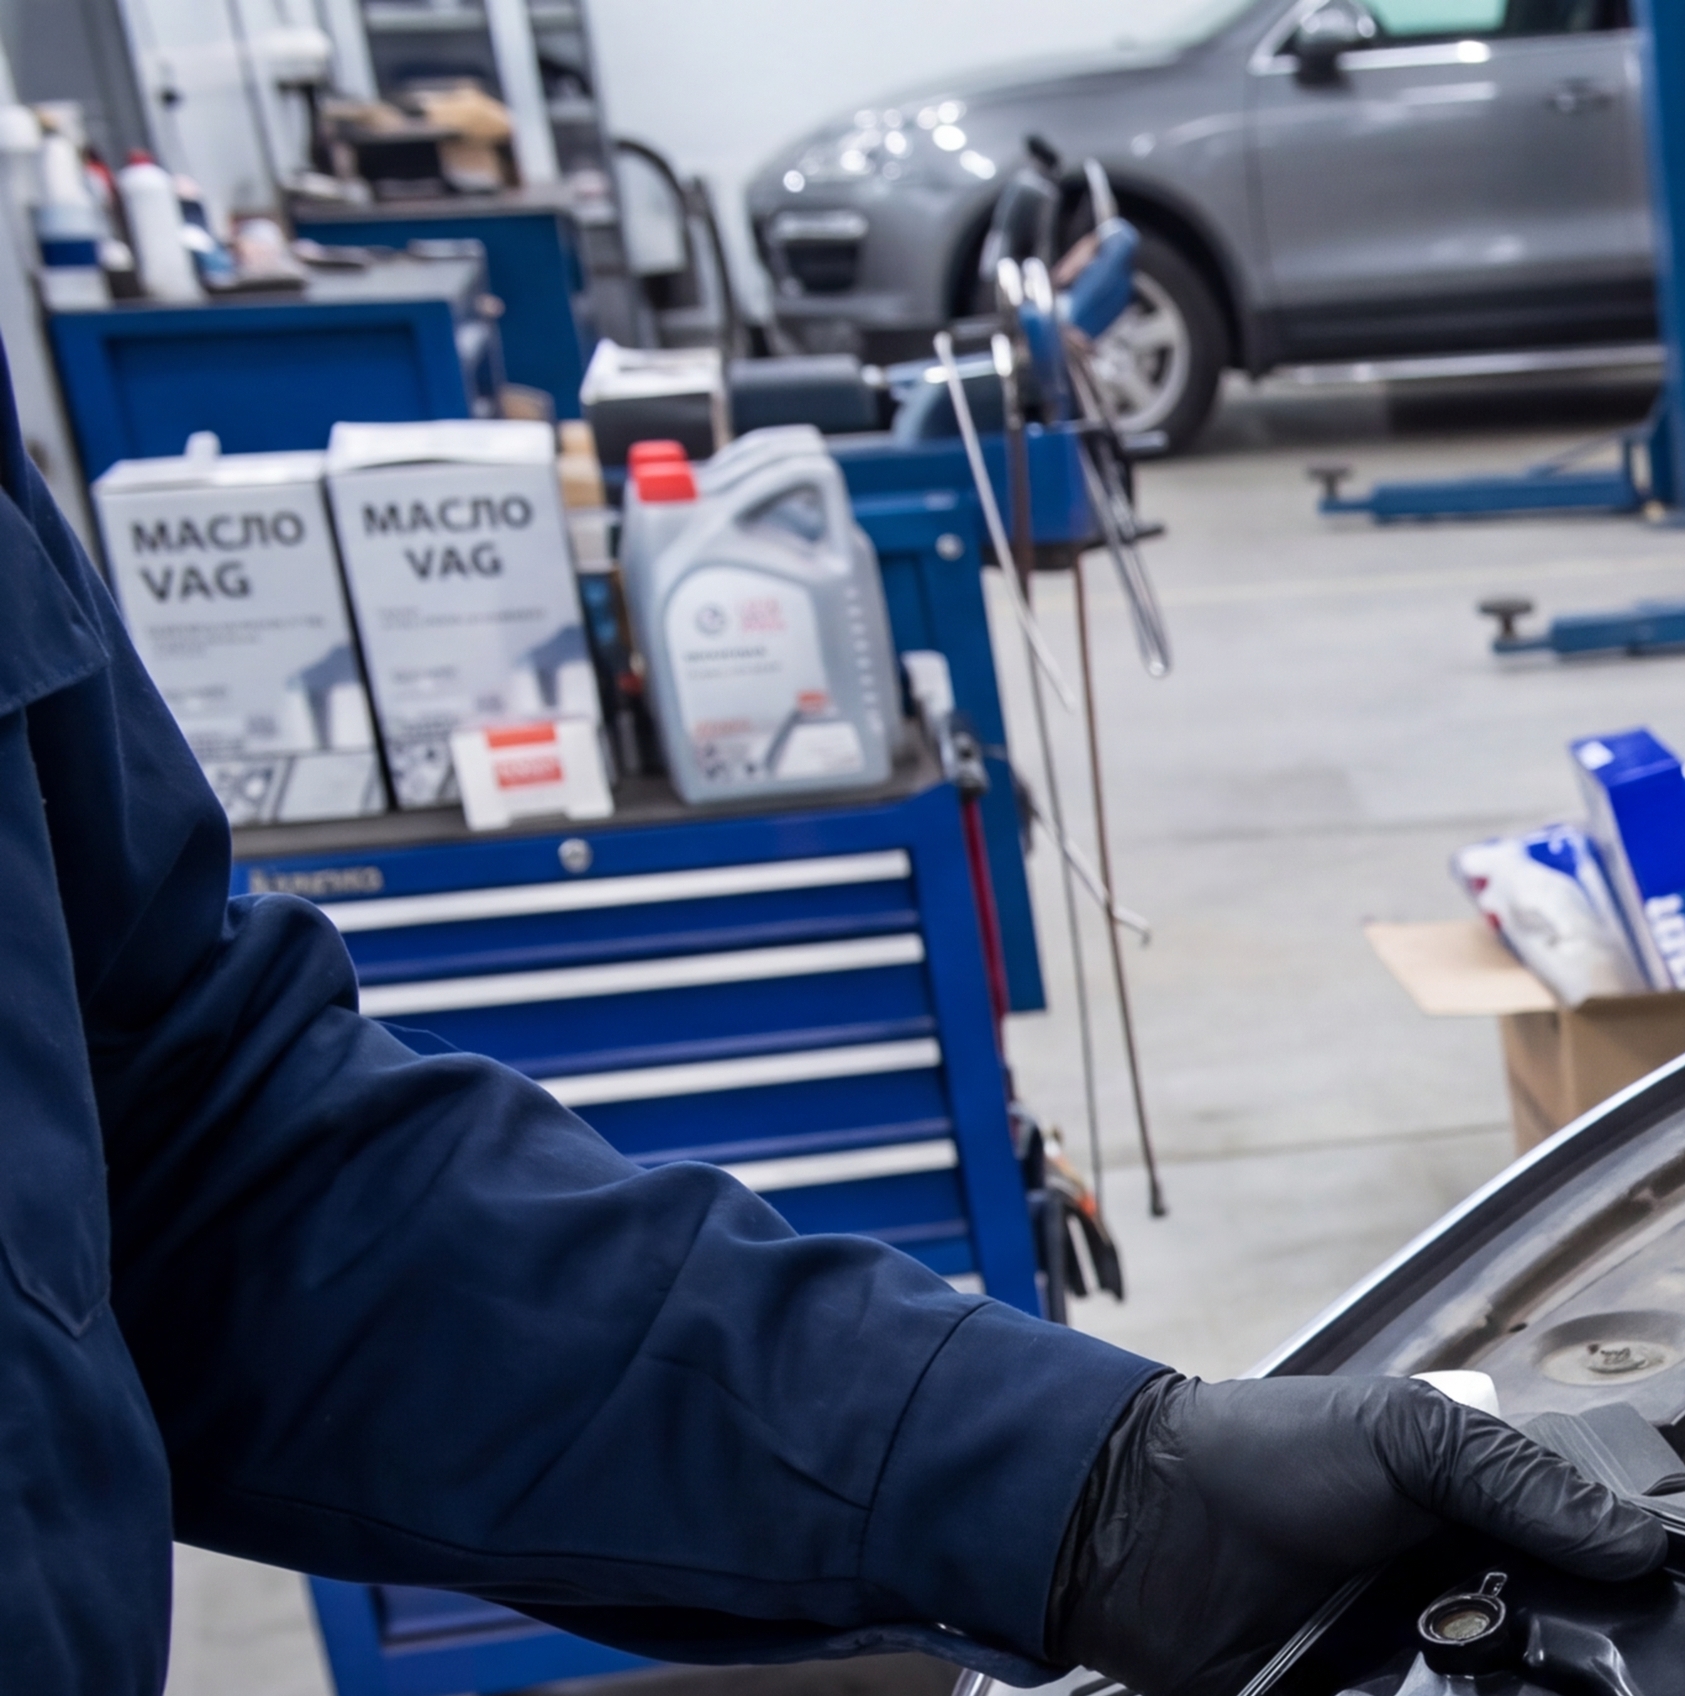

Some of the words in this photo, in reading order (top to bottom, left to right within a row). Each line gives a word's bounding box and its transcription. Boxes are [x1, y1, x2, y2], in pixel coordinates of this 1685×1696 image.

[131, 511, 305, 555] МАСЛО
[362, 496, 533, 537] МАСЛО
[406, 543, 502, 579] VAG
[141, 562, 251, 602] VAG
